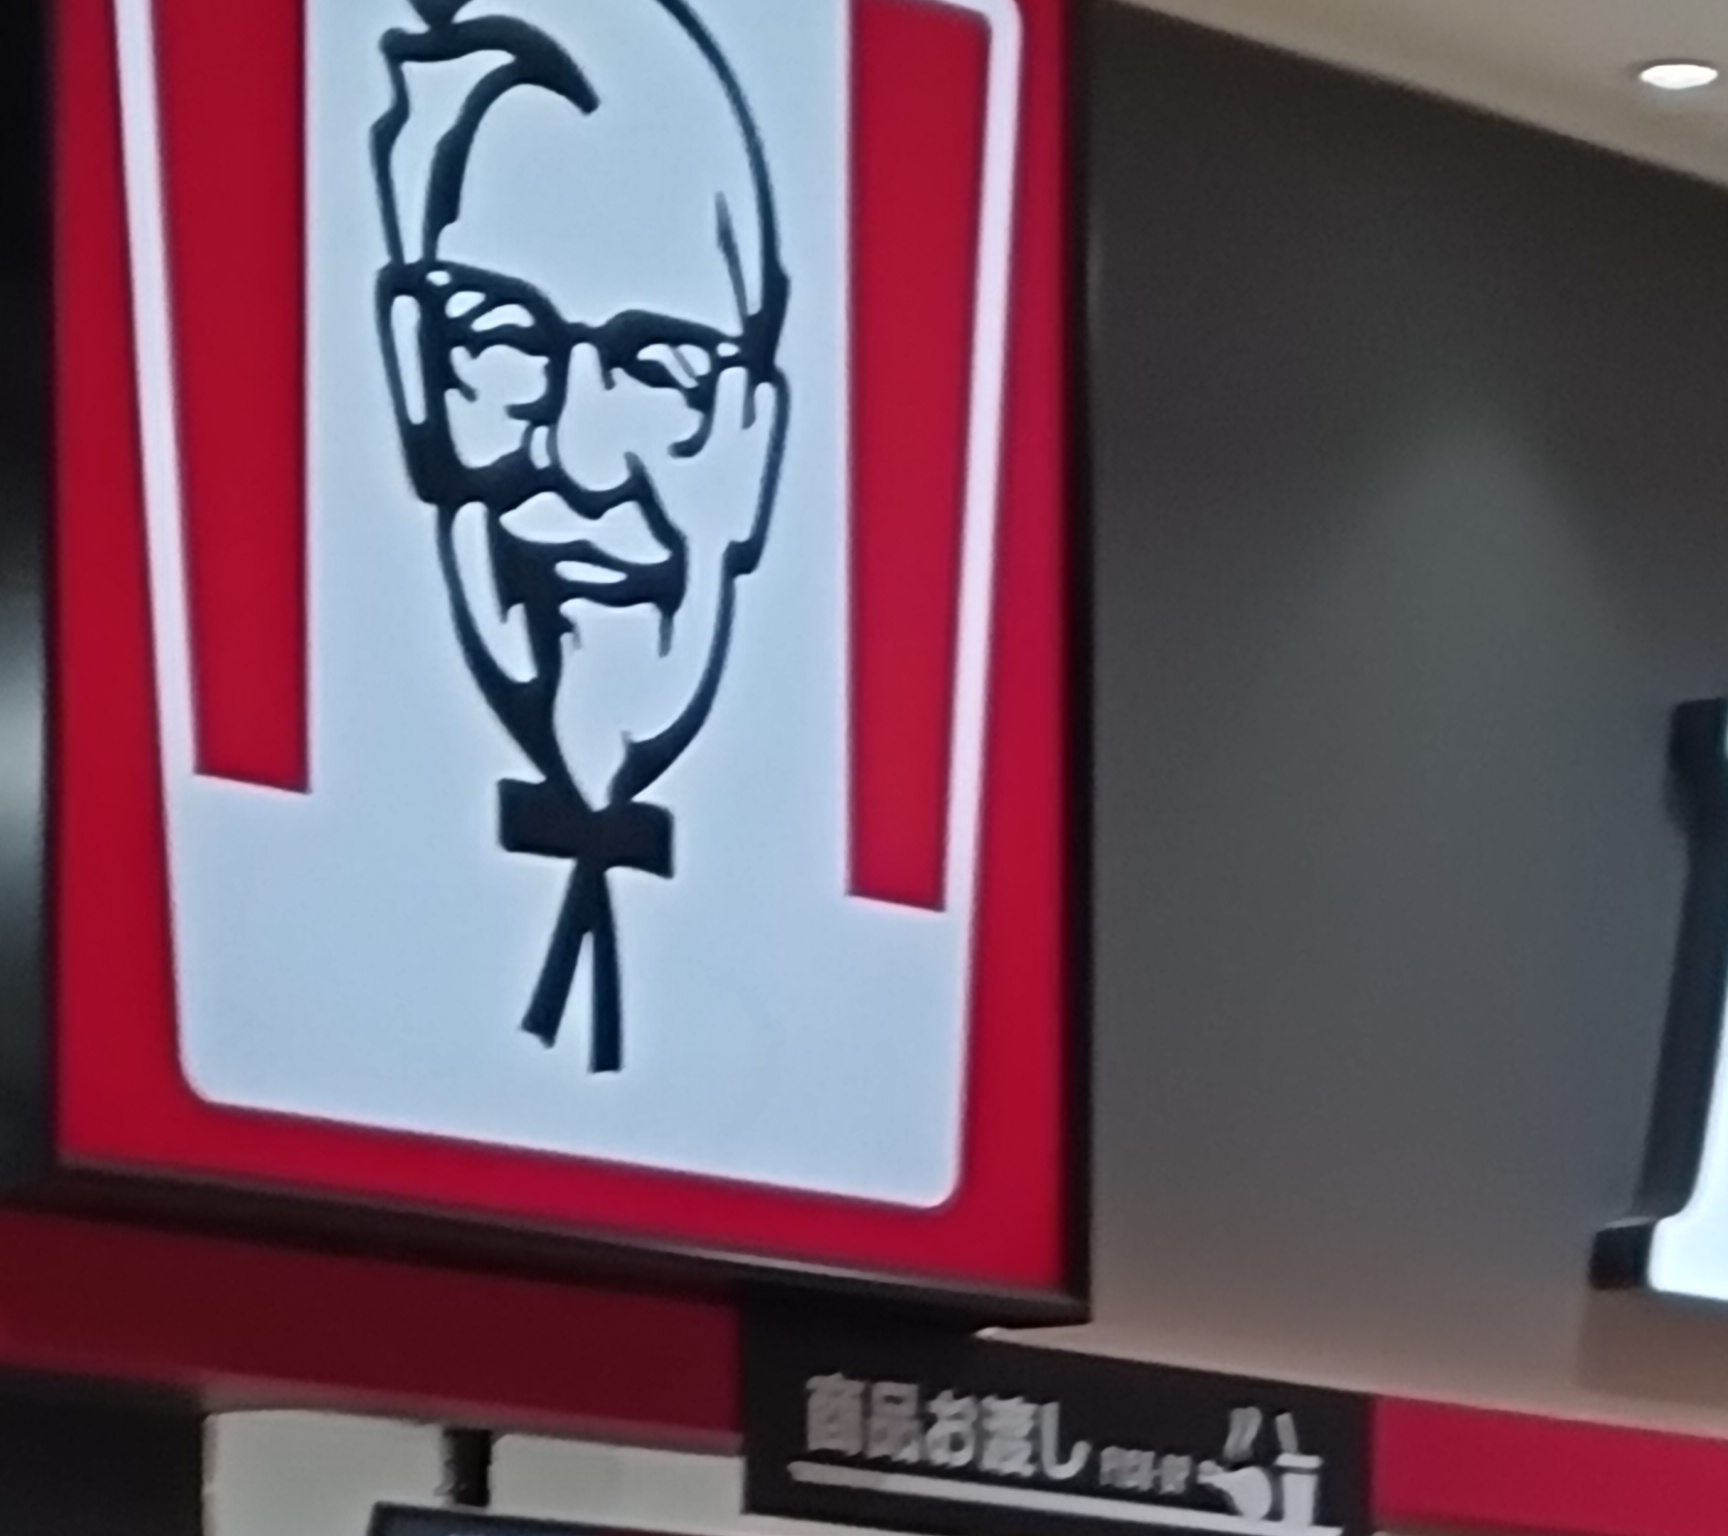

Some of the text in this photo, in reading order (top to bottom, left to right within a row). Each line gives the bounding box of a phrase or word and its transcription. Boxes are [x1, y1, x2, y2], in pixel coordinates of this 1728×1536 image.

[805, 1372, 1092, 1481] 商品お渡し
